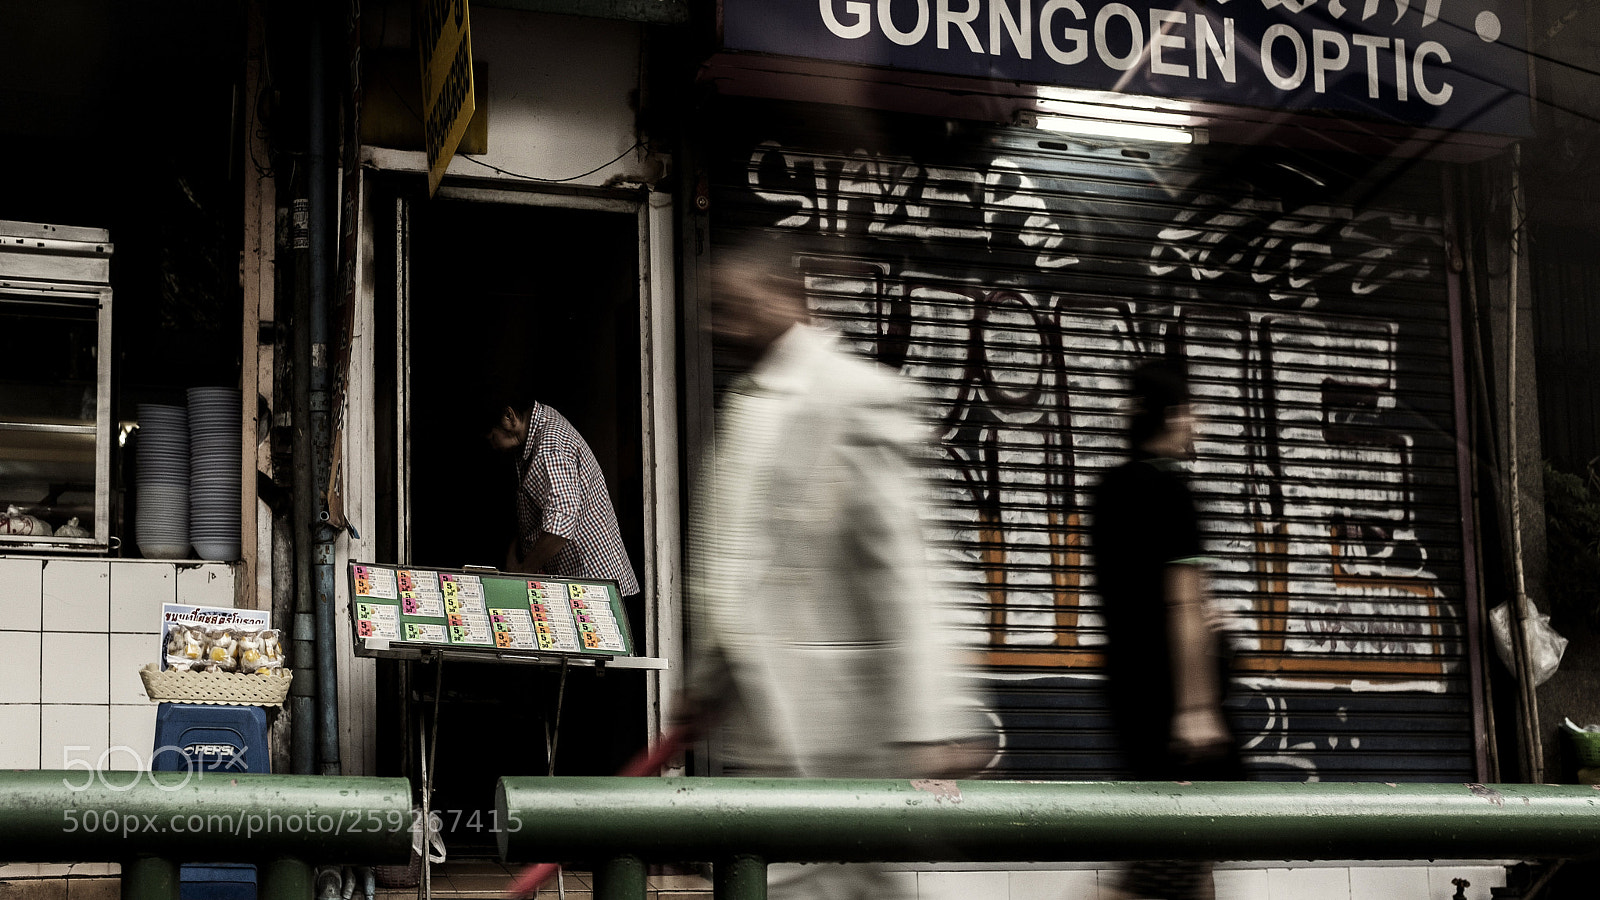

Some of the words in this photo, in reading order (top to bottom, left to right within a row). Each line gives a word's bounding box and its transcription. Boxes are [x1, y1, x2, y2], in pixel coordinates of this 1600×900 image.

[820, 0, 1236, 84] GORNGOEN
[1260, 24, 1454, 107] OPTIC
[165, 608, 264, 625] ขนมเปี๊ยะสตรโบราณ
[194, 744, 235, 756] PEPSI
